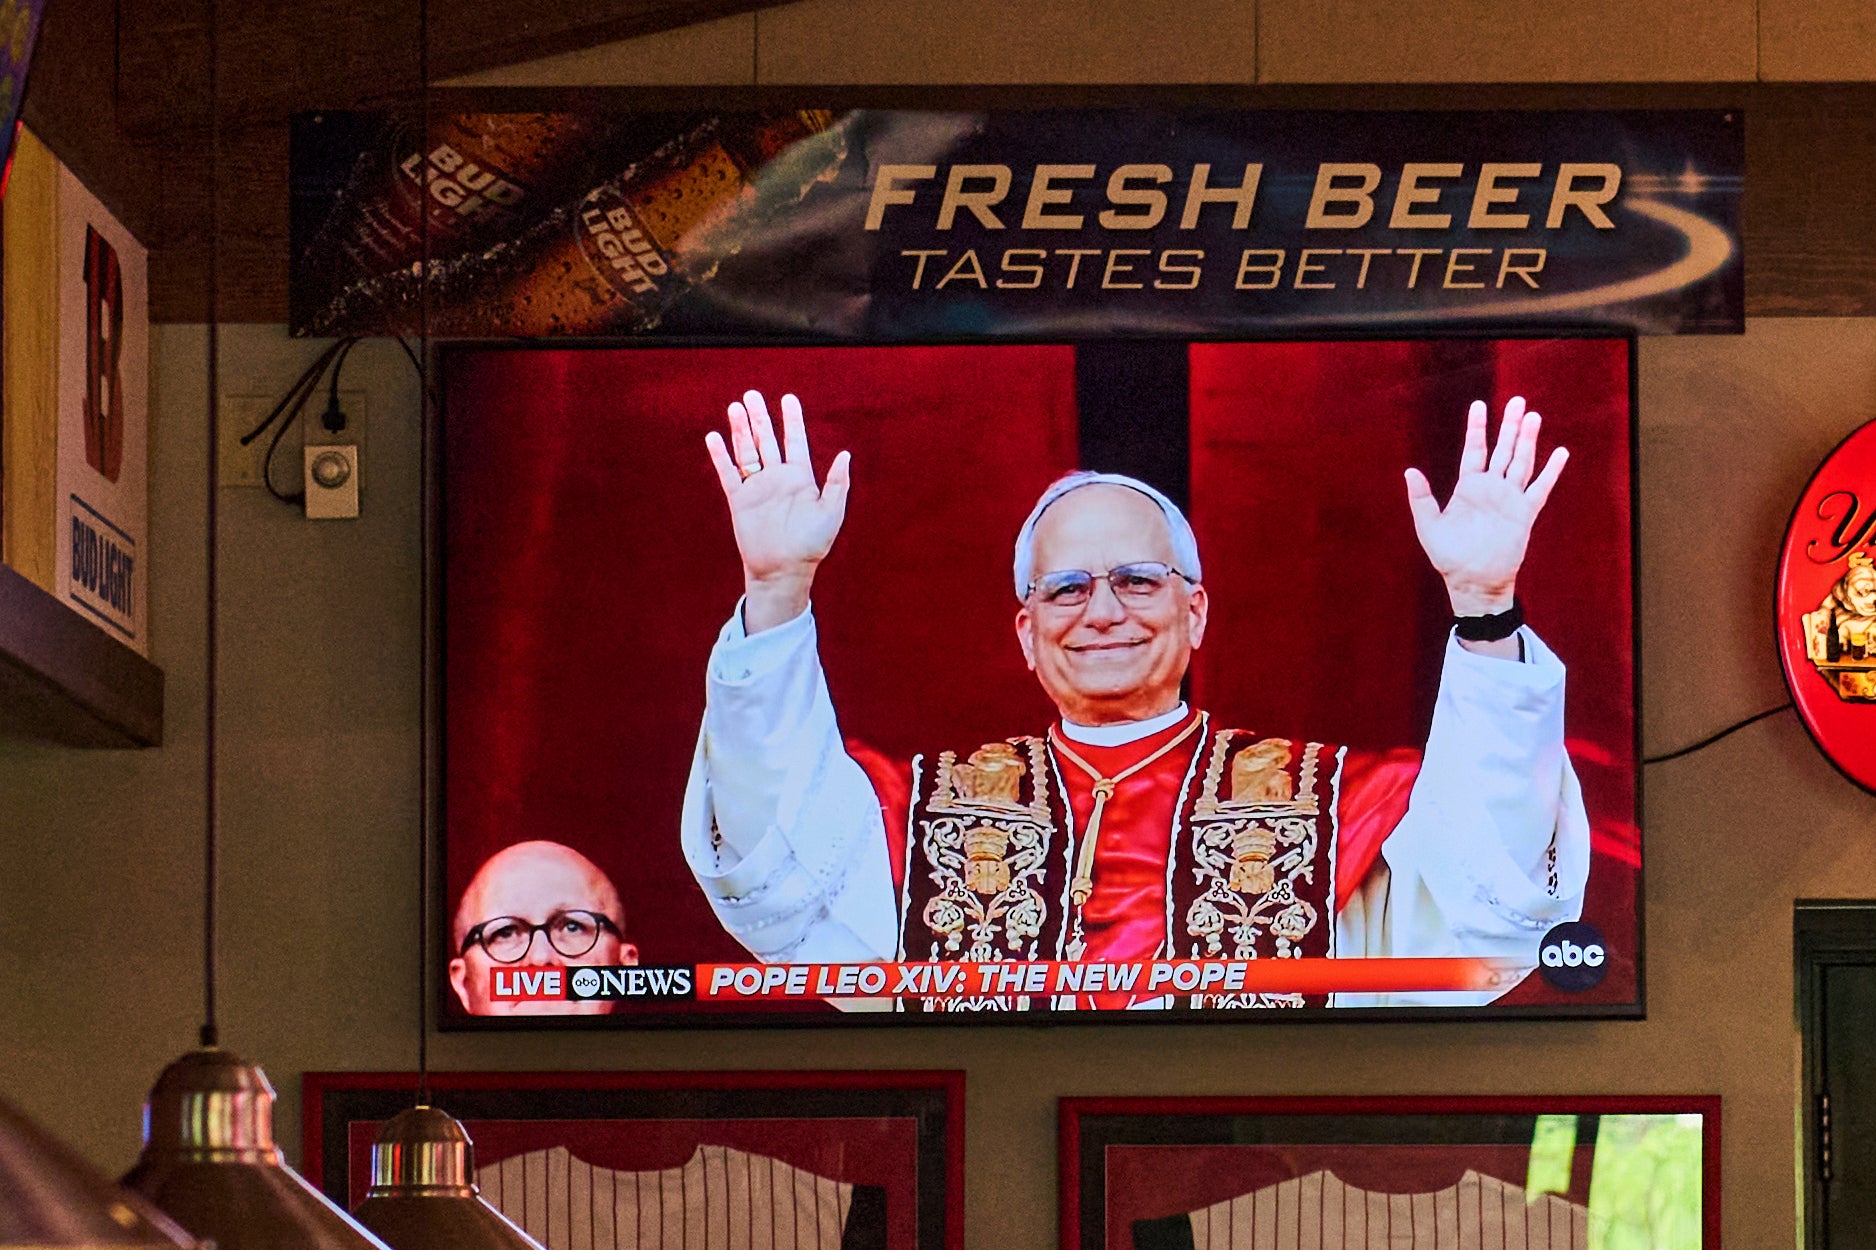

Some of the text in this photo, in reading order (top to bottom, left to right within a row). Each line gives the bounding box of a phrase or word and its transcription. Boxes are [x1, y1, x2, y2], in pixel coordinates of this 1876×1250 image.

[428, 143, 526, 207] BUD
[864, 160, 1622, 231] FRESH BEER
[581, 208, 660, 294] LIGHT
[605, 205, 669, 277] BUD
[900, 246, 1547, 291] TASTES BETTER
[83, 222, 125, 485] B
[72, 515, 136, 618] BUD LIGHT
[1848, 551, 1874, 569] &
[710, 963, 1249, 996] POPE LEO XIV: THE NEW POPE
[1541, 939, 1605, 968] abc
[495, 971, 561, 996] LIVE
[601, 969, 691, 996] NEWS
